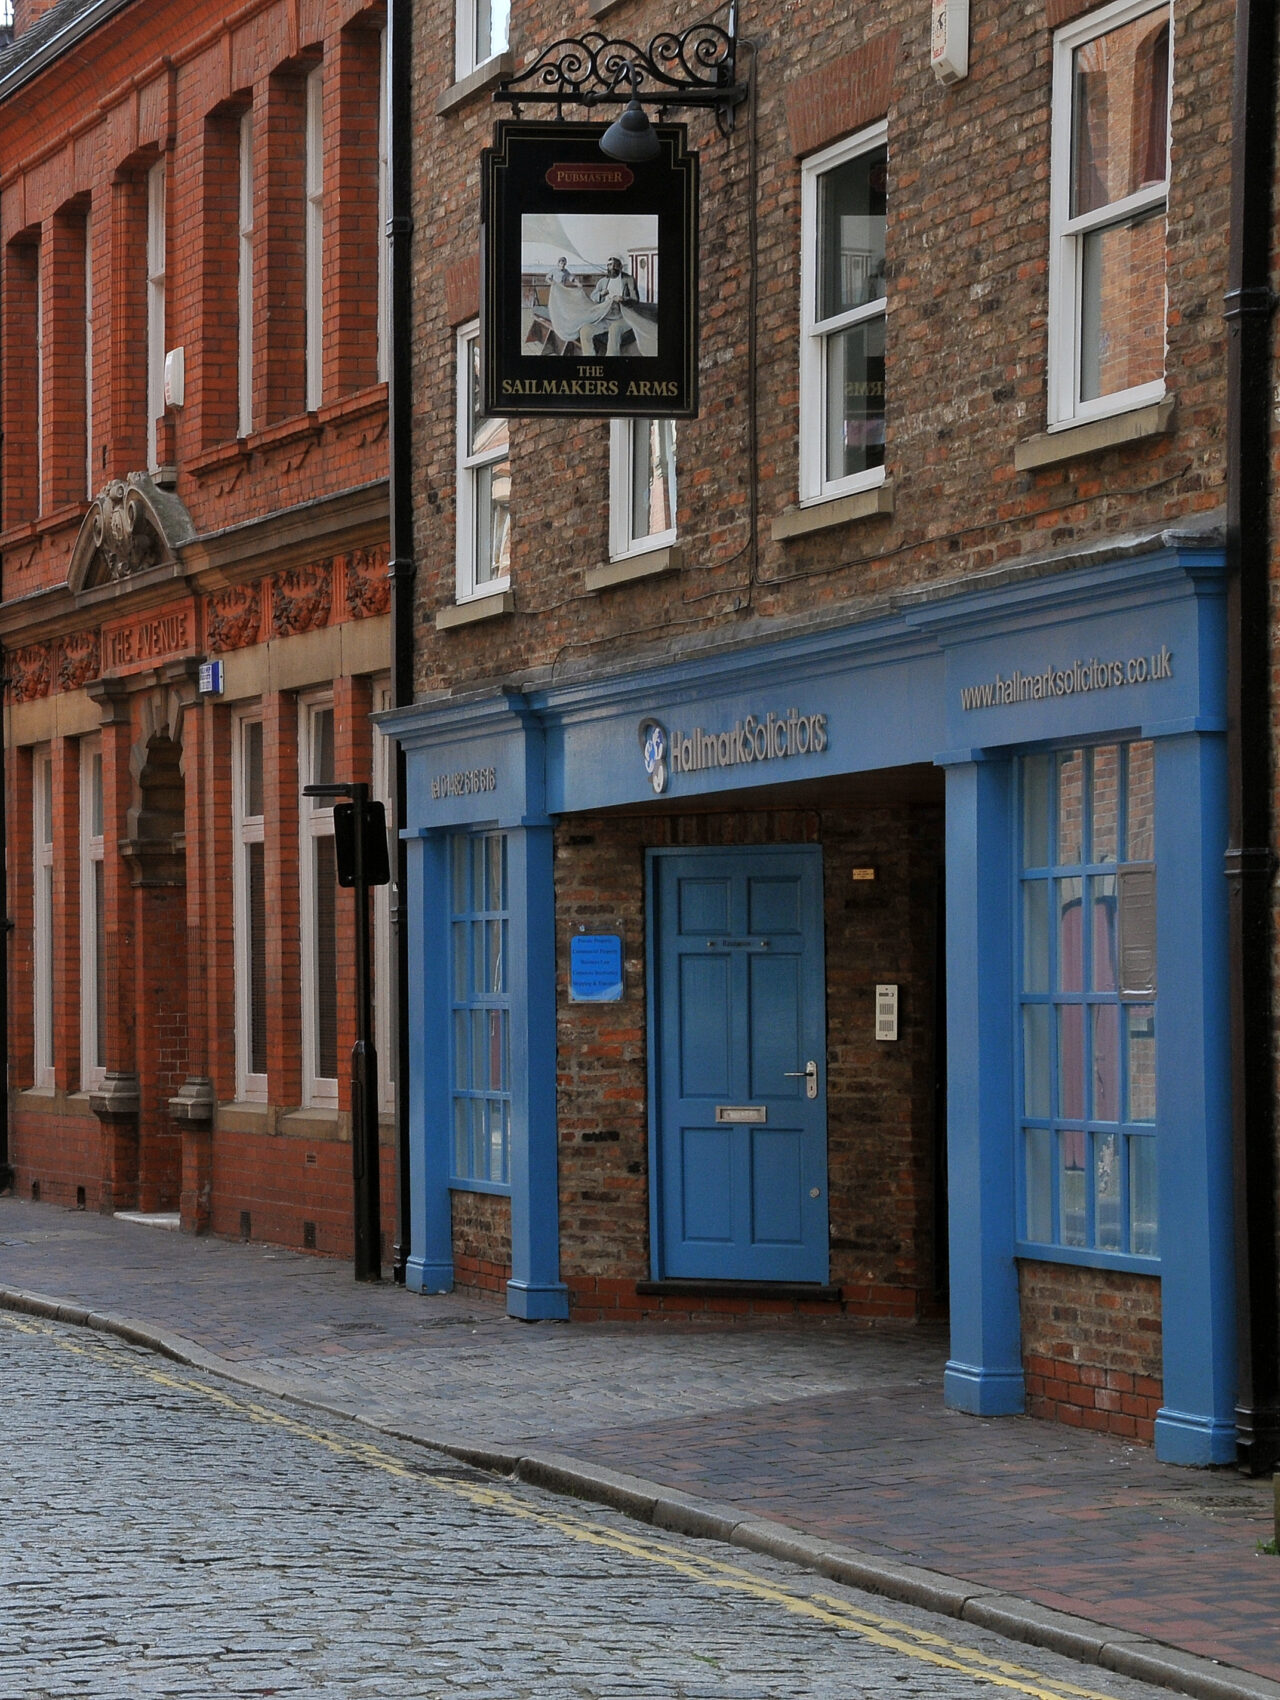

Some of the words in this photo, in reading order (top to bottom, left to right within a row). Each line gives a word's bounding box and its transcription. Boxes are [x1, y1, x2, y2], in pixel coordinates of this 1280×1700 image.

[557, 171, 623, 183] PUBMASTER
[576, 365, 604, 377] THE
[502, 379, 619, 395] SAILMAKERS
[625, 381, 679, 396] ARMS
[108, 629, 133, 667] THE
[135, 613, 188, 659] AVENUE
[960, 644, 1173, 711] www.hallmarksolicitors.co.uk
